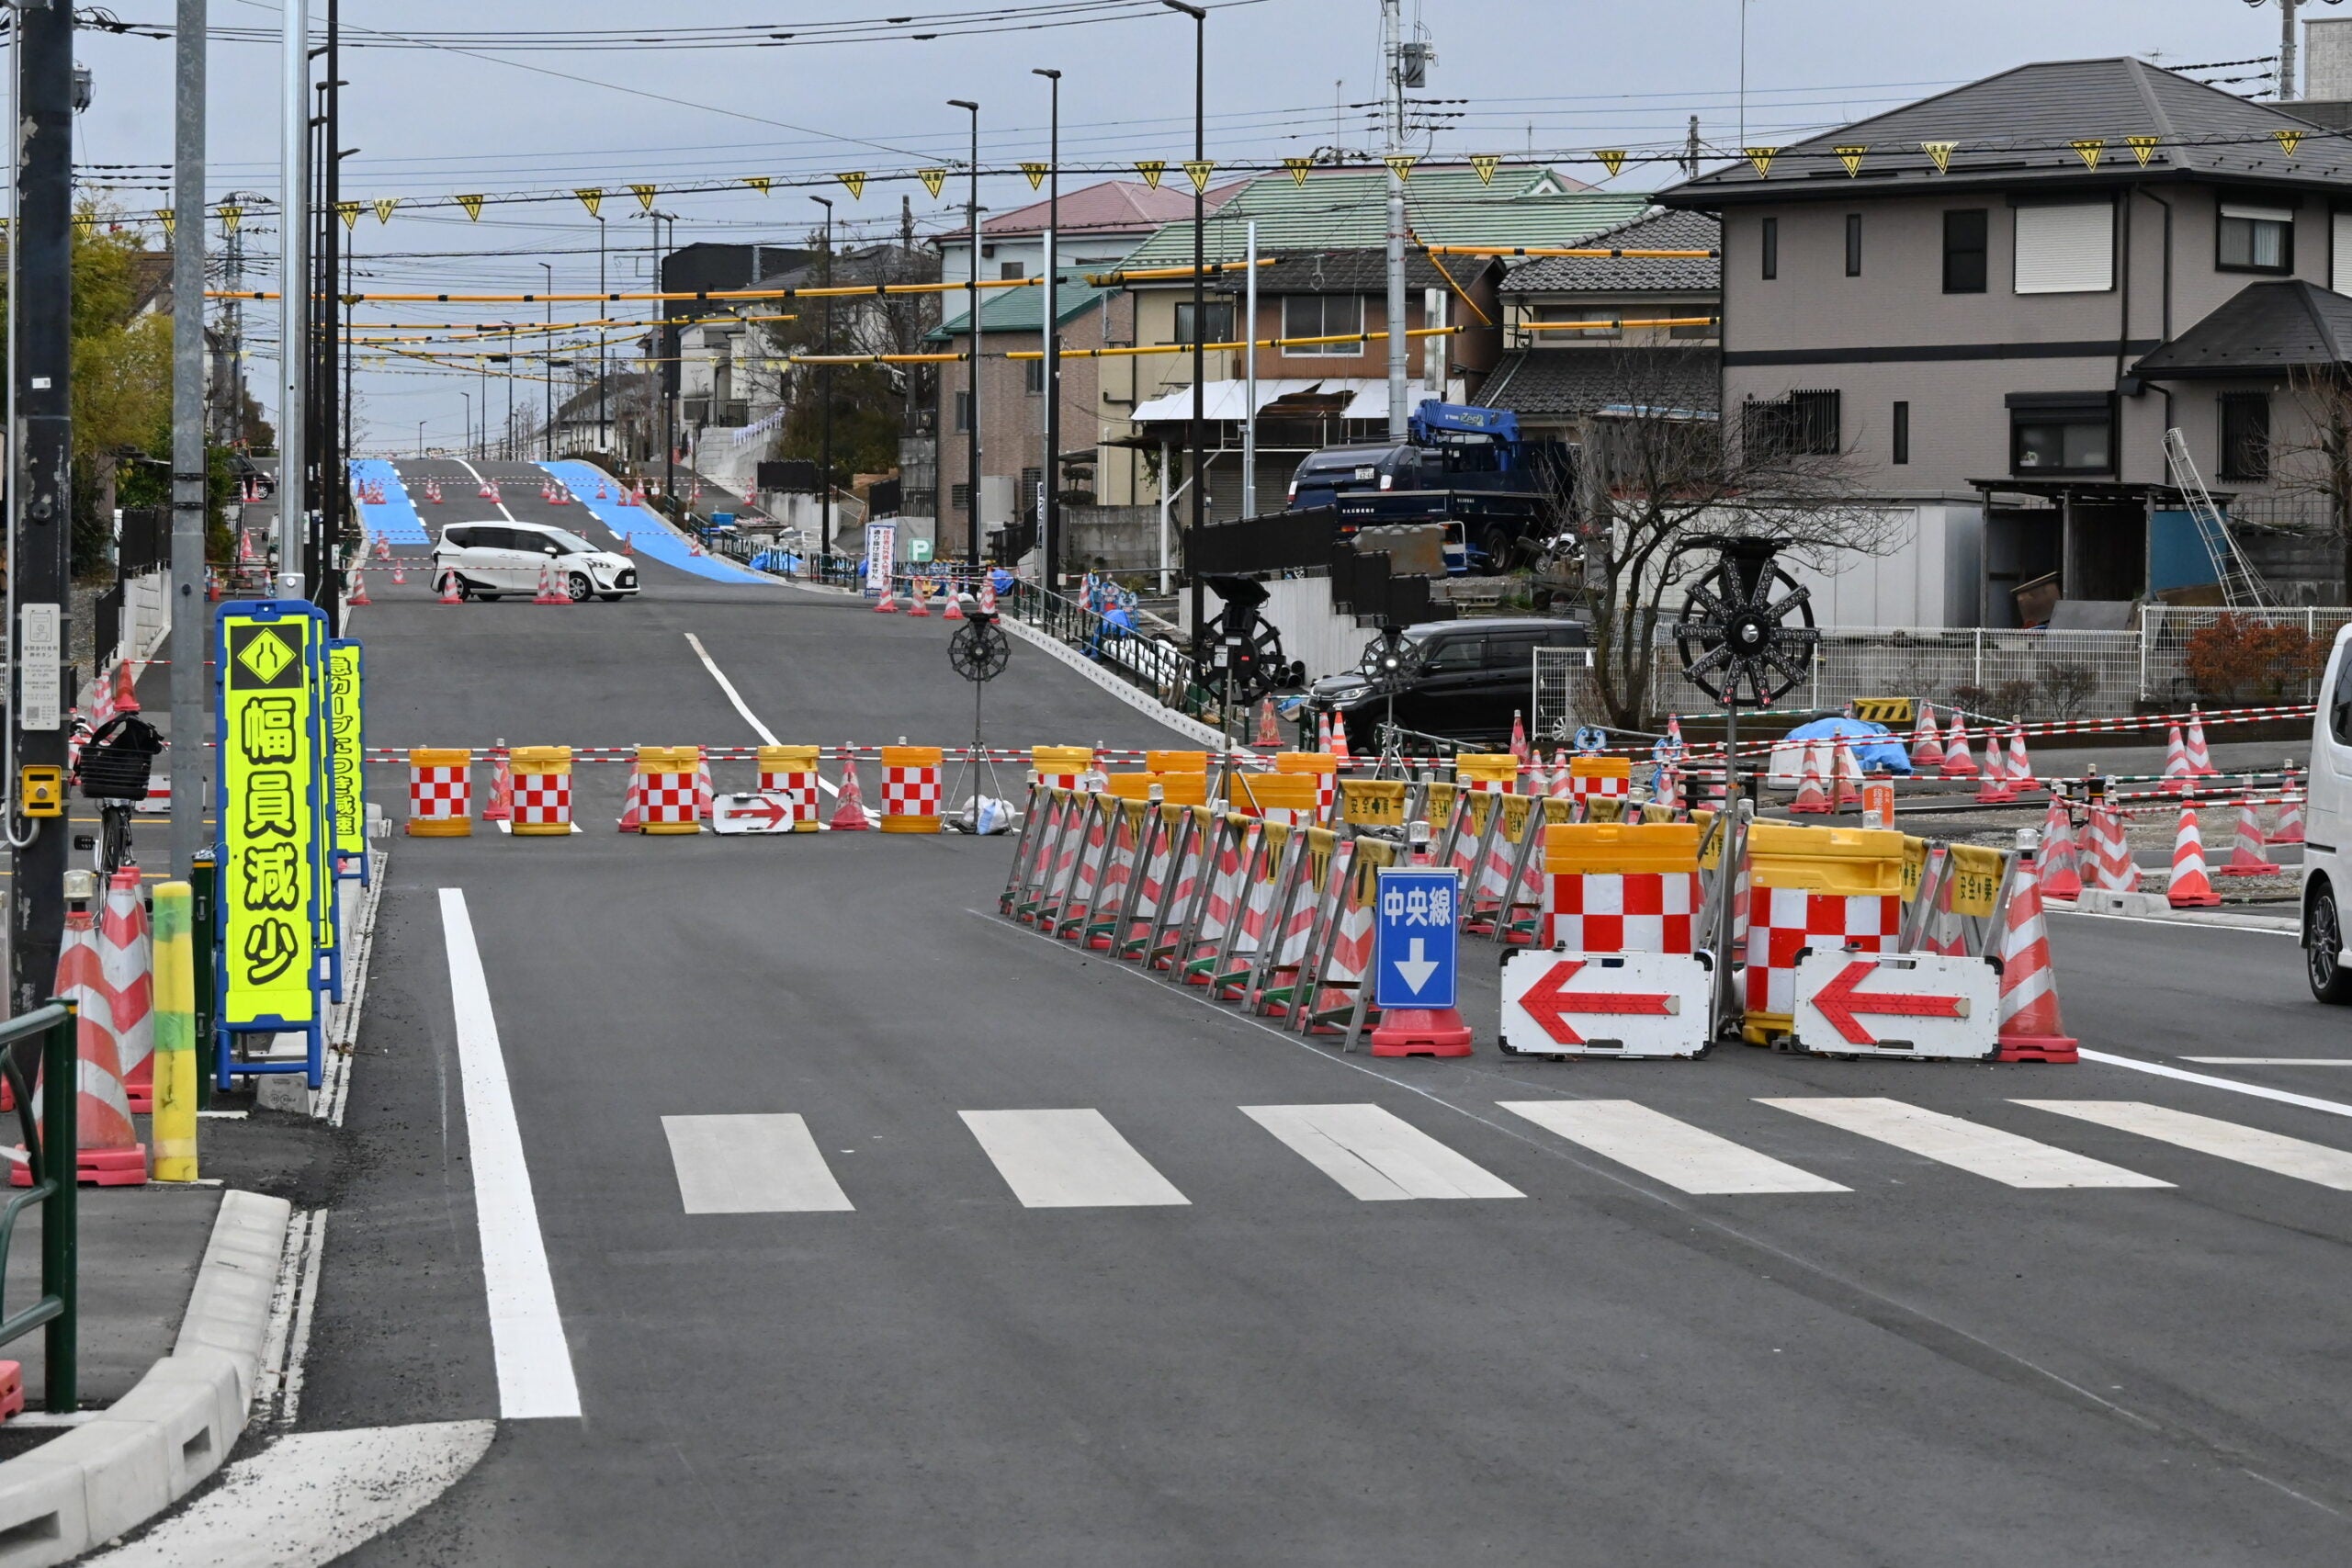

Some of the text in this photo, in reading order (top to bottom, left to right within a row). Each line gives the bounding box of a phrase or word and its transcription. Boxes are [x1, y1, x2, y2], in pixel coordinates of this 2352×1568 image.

[924, 173, 940, 181] 注意
[913, 540, 929, 561] P
[242, 696, 299, 986] 幅員減少
[1384, 886, 1451, 927] 中央線
